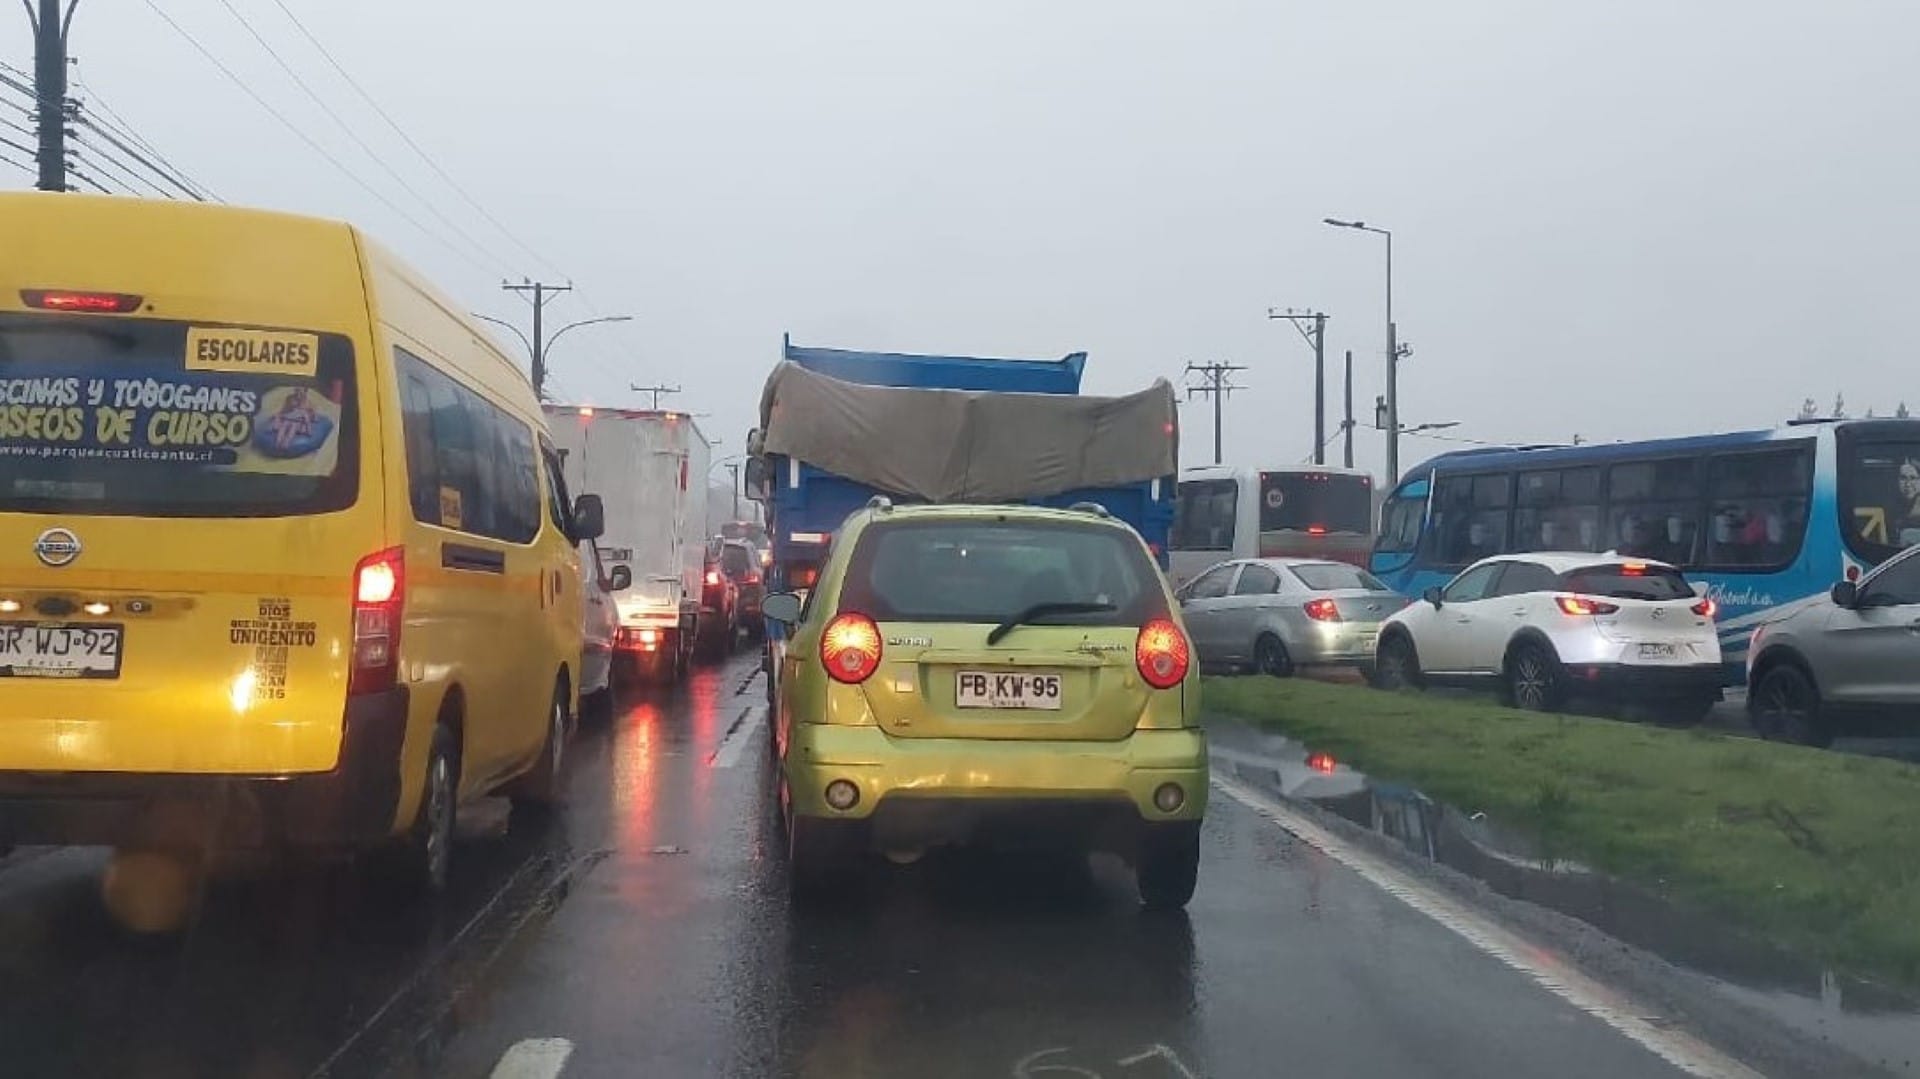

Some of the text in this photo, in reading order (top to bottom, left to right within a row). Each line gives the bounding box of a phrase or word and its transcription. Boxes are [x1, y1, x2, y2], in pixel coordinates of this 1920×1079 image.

[196, 338, 310, 366] ESCOLARES
[87, 378, 105, 406] Y
[114, 377, 257, 413] TOBOGANES
[96, 405, 137, 445] DE
[147, 410, 250, 446] CURSO
[230, 628, 316, 647] UNIGENITO
